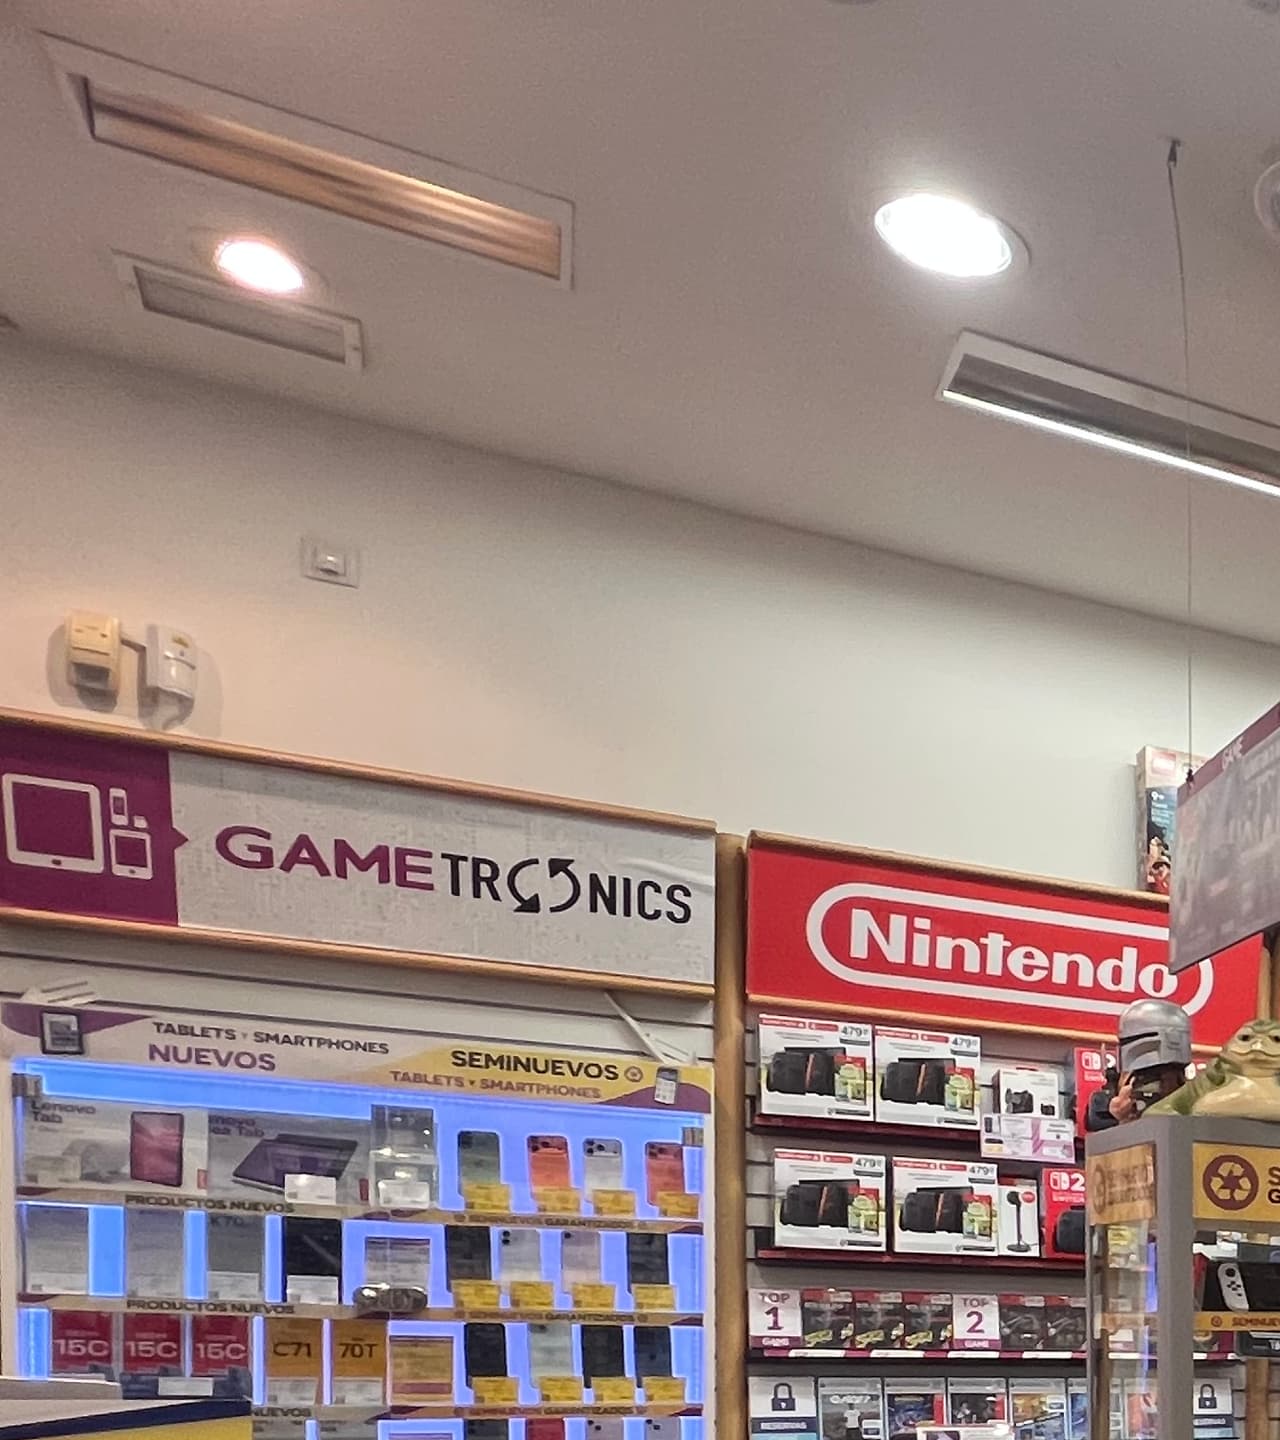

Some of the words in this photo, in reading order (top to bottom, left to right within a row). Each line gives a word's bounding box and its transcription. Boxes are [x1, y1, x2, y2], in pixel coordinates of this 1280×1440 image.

[849, 908, 1179, 998] Nintendo
[153, 1022, 236, 1041] TABLETS
[253, 1031, 390, 1055] SMARTPHONES
[149, 1044, 277, 1072] NUEVOS
[452, 1050, 619, 1081] SEMINUEVOS
[390, 1071, 465, 1089] TABLETS
[480, 1077, 602, 1100] SMARTPHONES
[125, 1195, 227, 1211] PRODUCTOS
[231, 1201, 295, 1214] NUEVOS
[126, 1300, 227, 1312] PRODUCTOS
[231, 1303, 295, 1315] NUEVOS
[759, 1293, 790, 1305] TOP
[764, 1308, 784, 1331] 1
[965, 1311, 985, 1334] 2
[54, 1339, 110, 1358] 15C
[126, 1340, 183, 1361] 15C
[197, 1342, 249, 1361] 15C
[272, 1342, 312, 1359] C71
